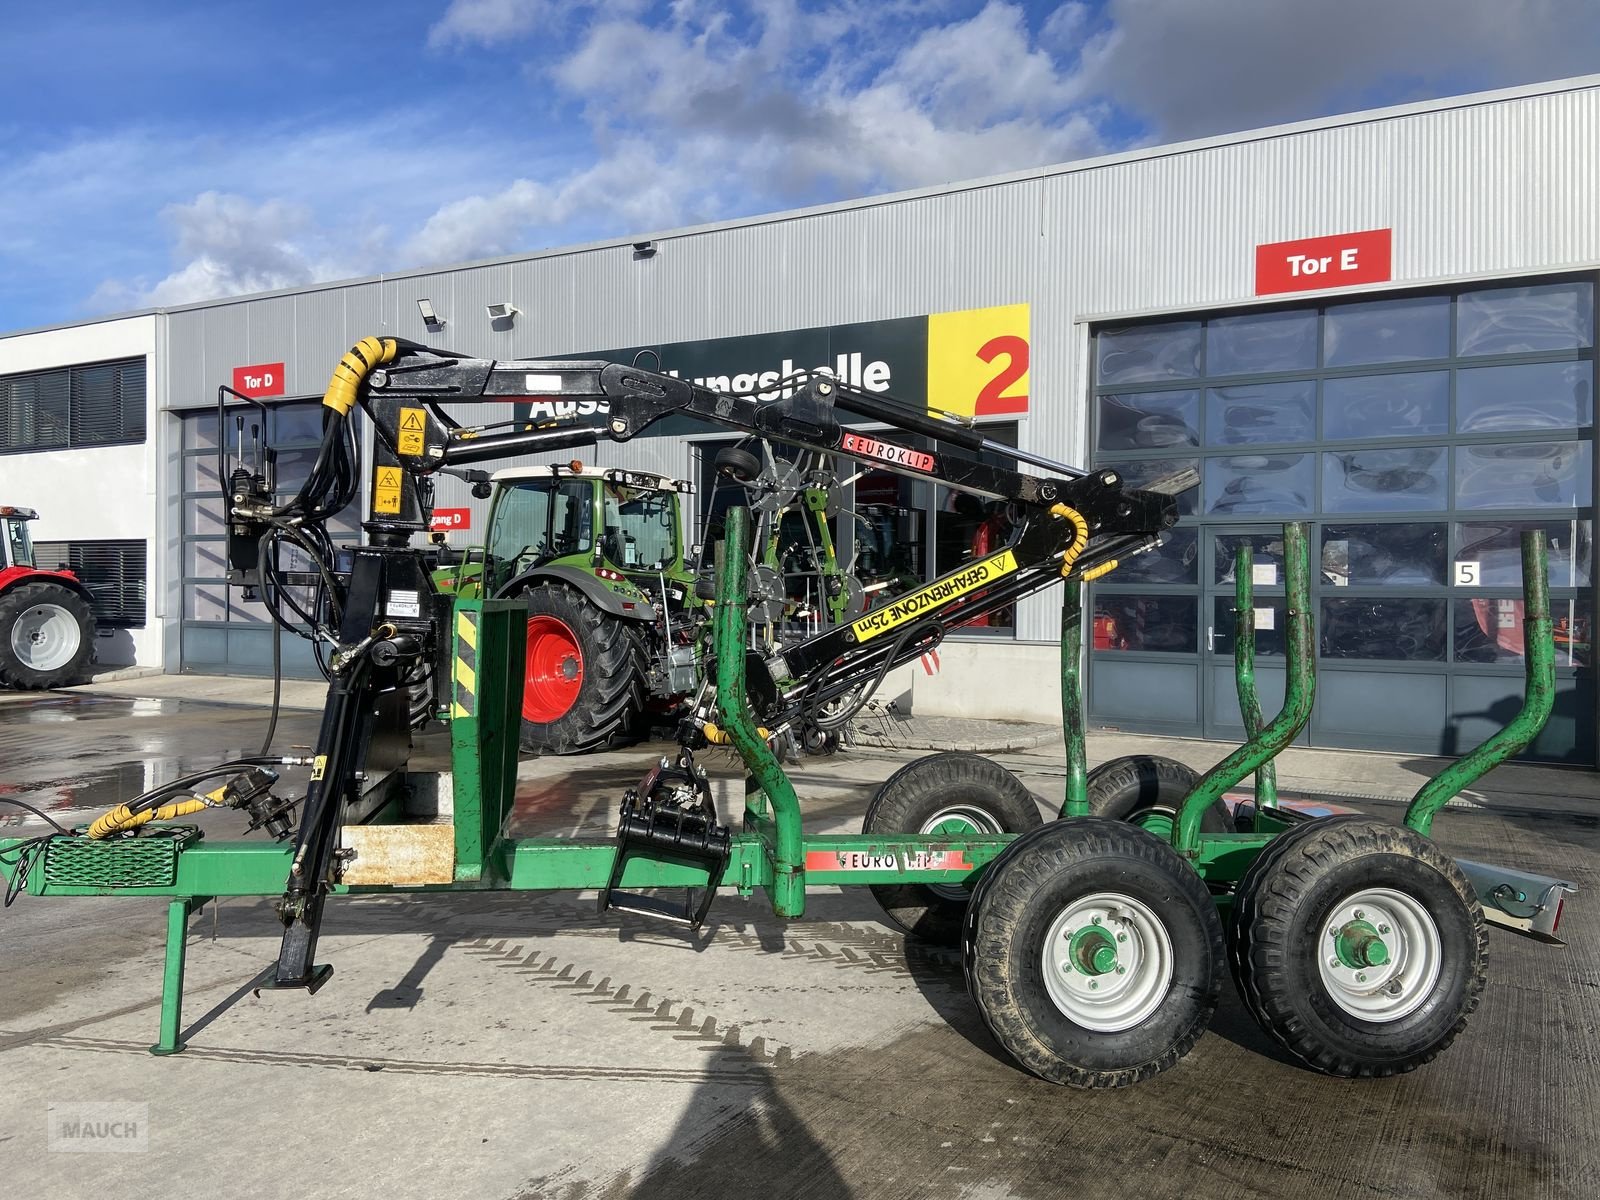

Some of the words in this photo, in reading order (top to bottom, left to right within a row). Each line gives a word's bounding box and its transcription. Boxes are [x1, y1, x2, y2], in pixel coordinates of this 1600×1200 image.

[1286, 254, 1333, 277] Tor
[1340, 248, 1359, 271] E
[243, 375, 262, 389] Tor
[264, 373, 273, 387] D
[974, 335, 1030, 416] 2
[856, 438, 930, 469] EUROKLIP
[430, 515, 453, 526] gang
[453, 513, 462, 524] D
[1459, 564, 1474, 584] 5
[890, 565, 989, 620] GEFAHRENZONE
[857, 611, 890, 633] 25m
